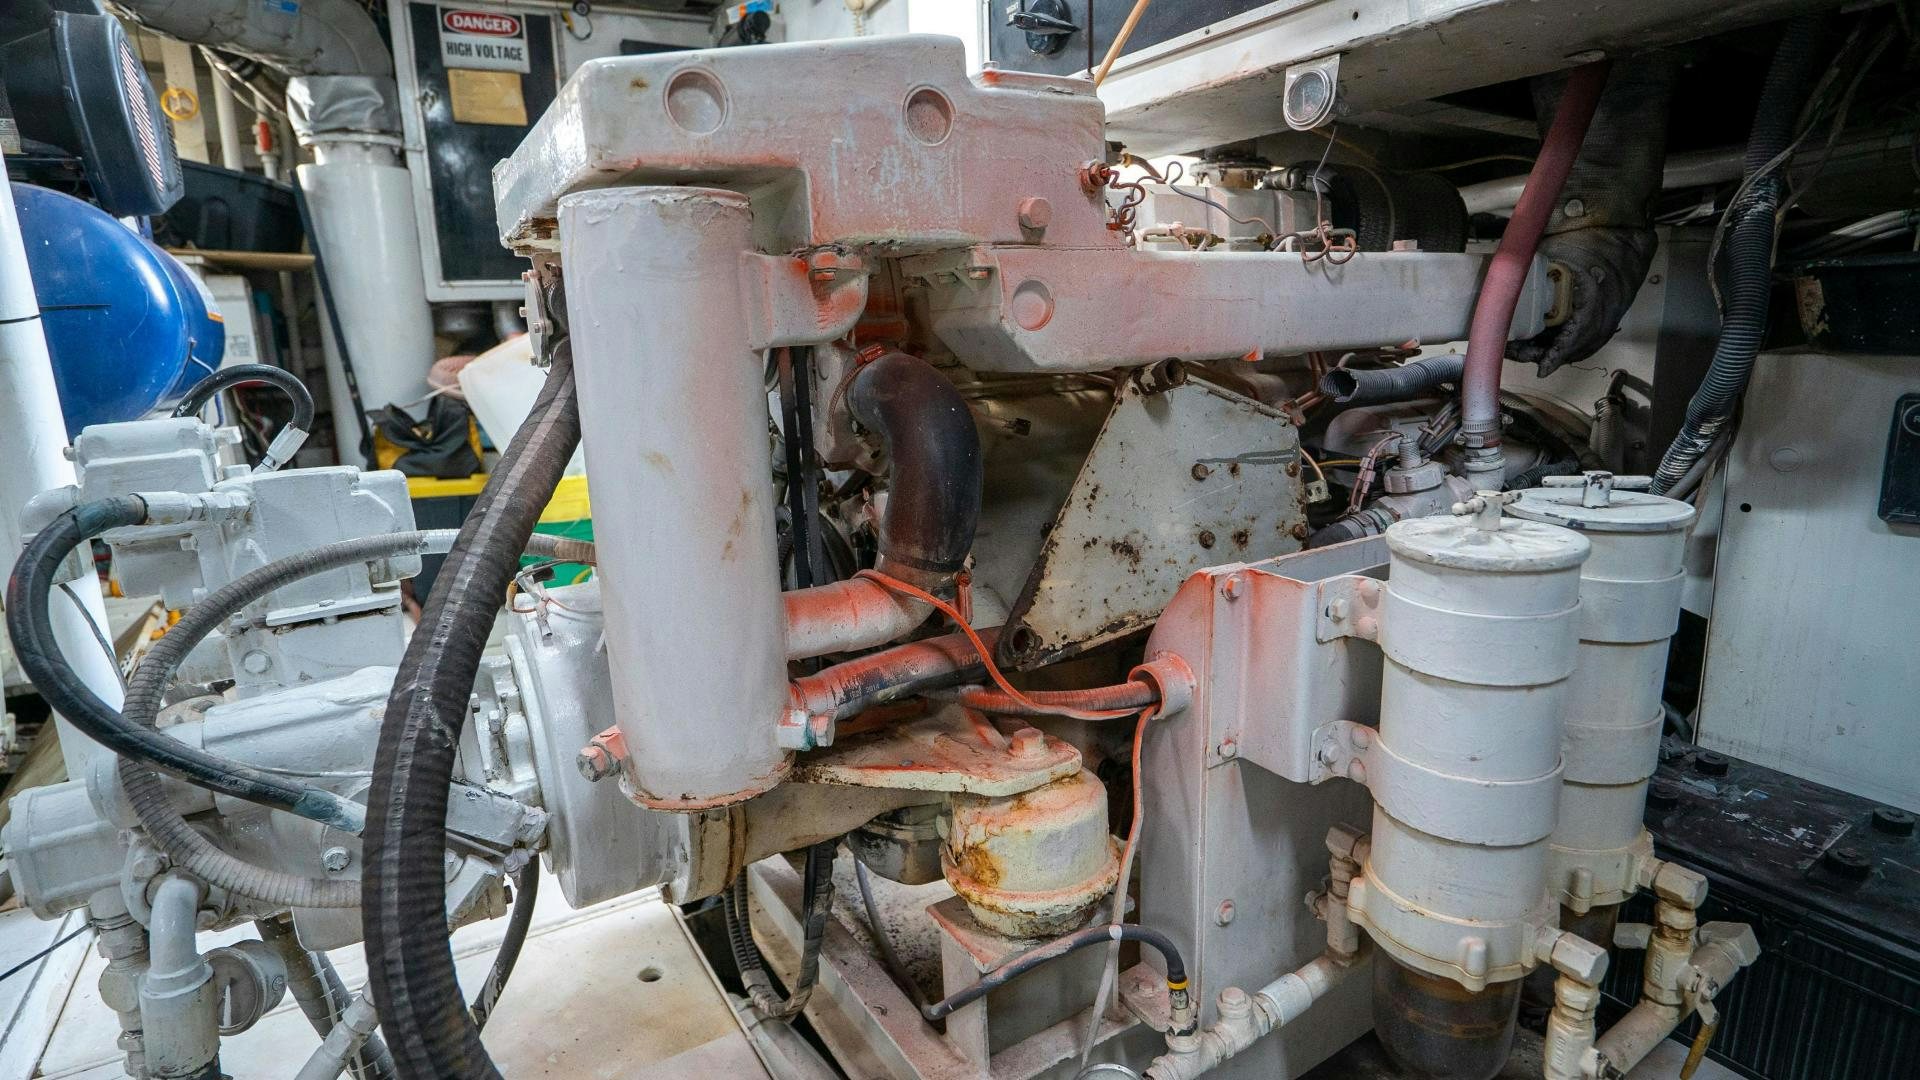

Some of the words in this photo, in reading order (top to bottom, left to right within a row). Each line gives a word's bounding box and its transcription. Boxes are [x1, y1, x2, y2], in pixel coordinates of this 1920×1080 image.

[452, 15, 512, 32] DANGER
[446, 42, 473, 57] HIGH
[475, 45, 524, 61] VOLTAGE
